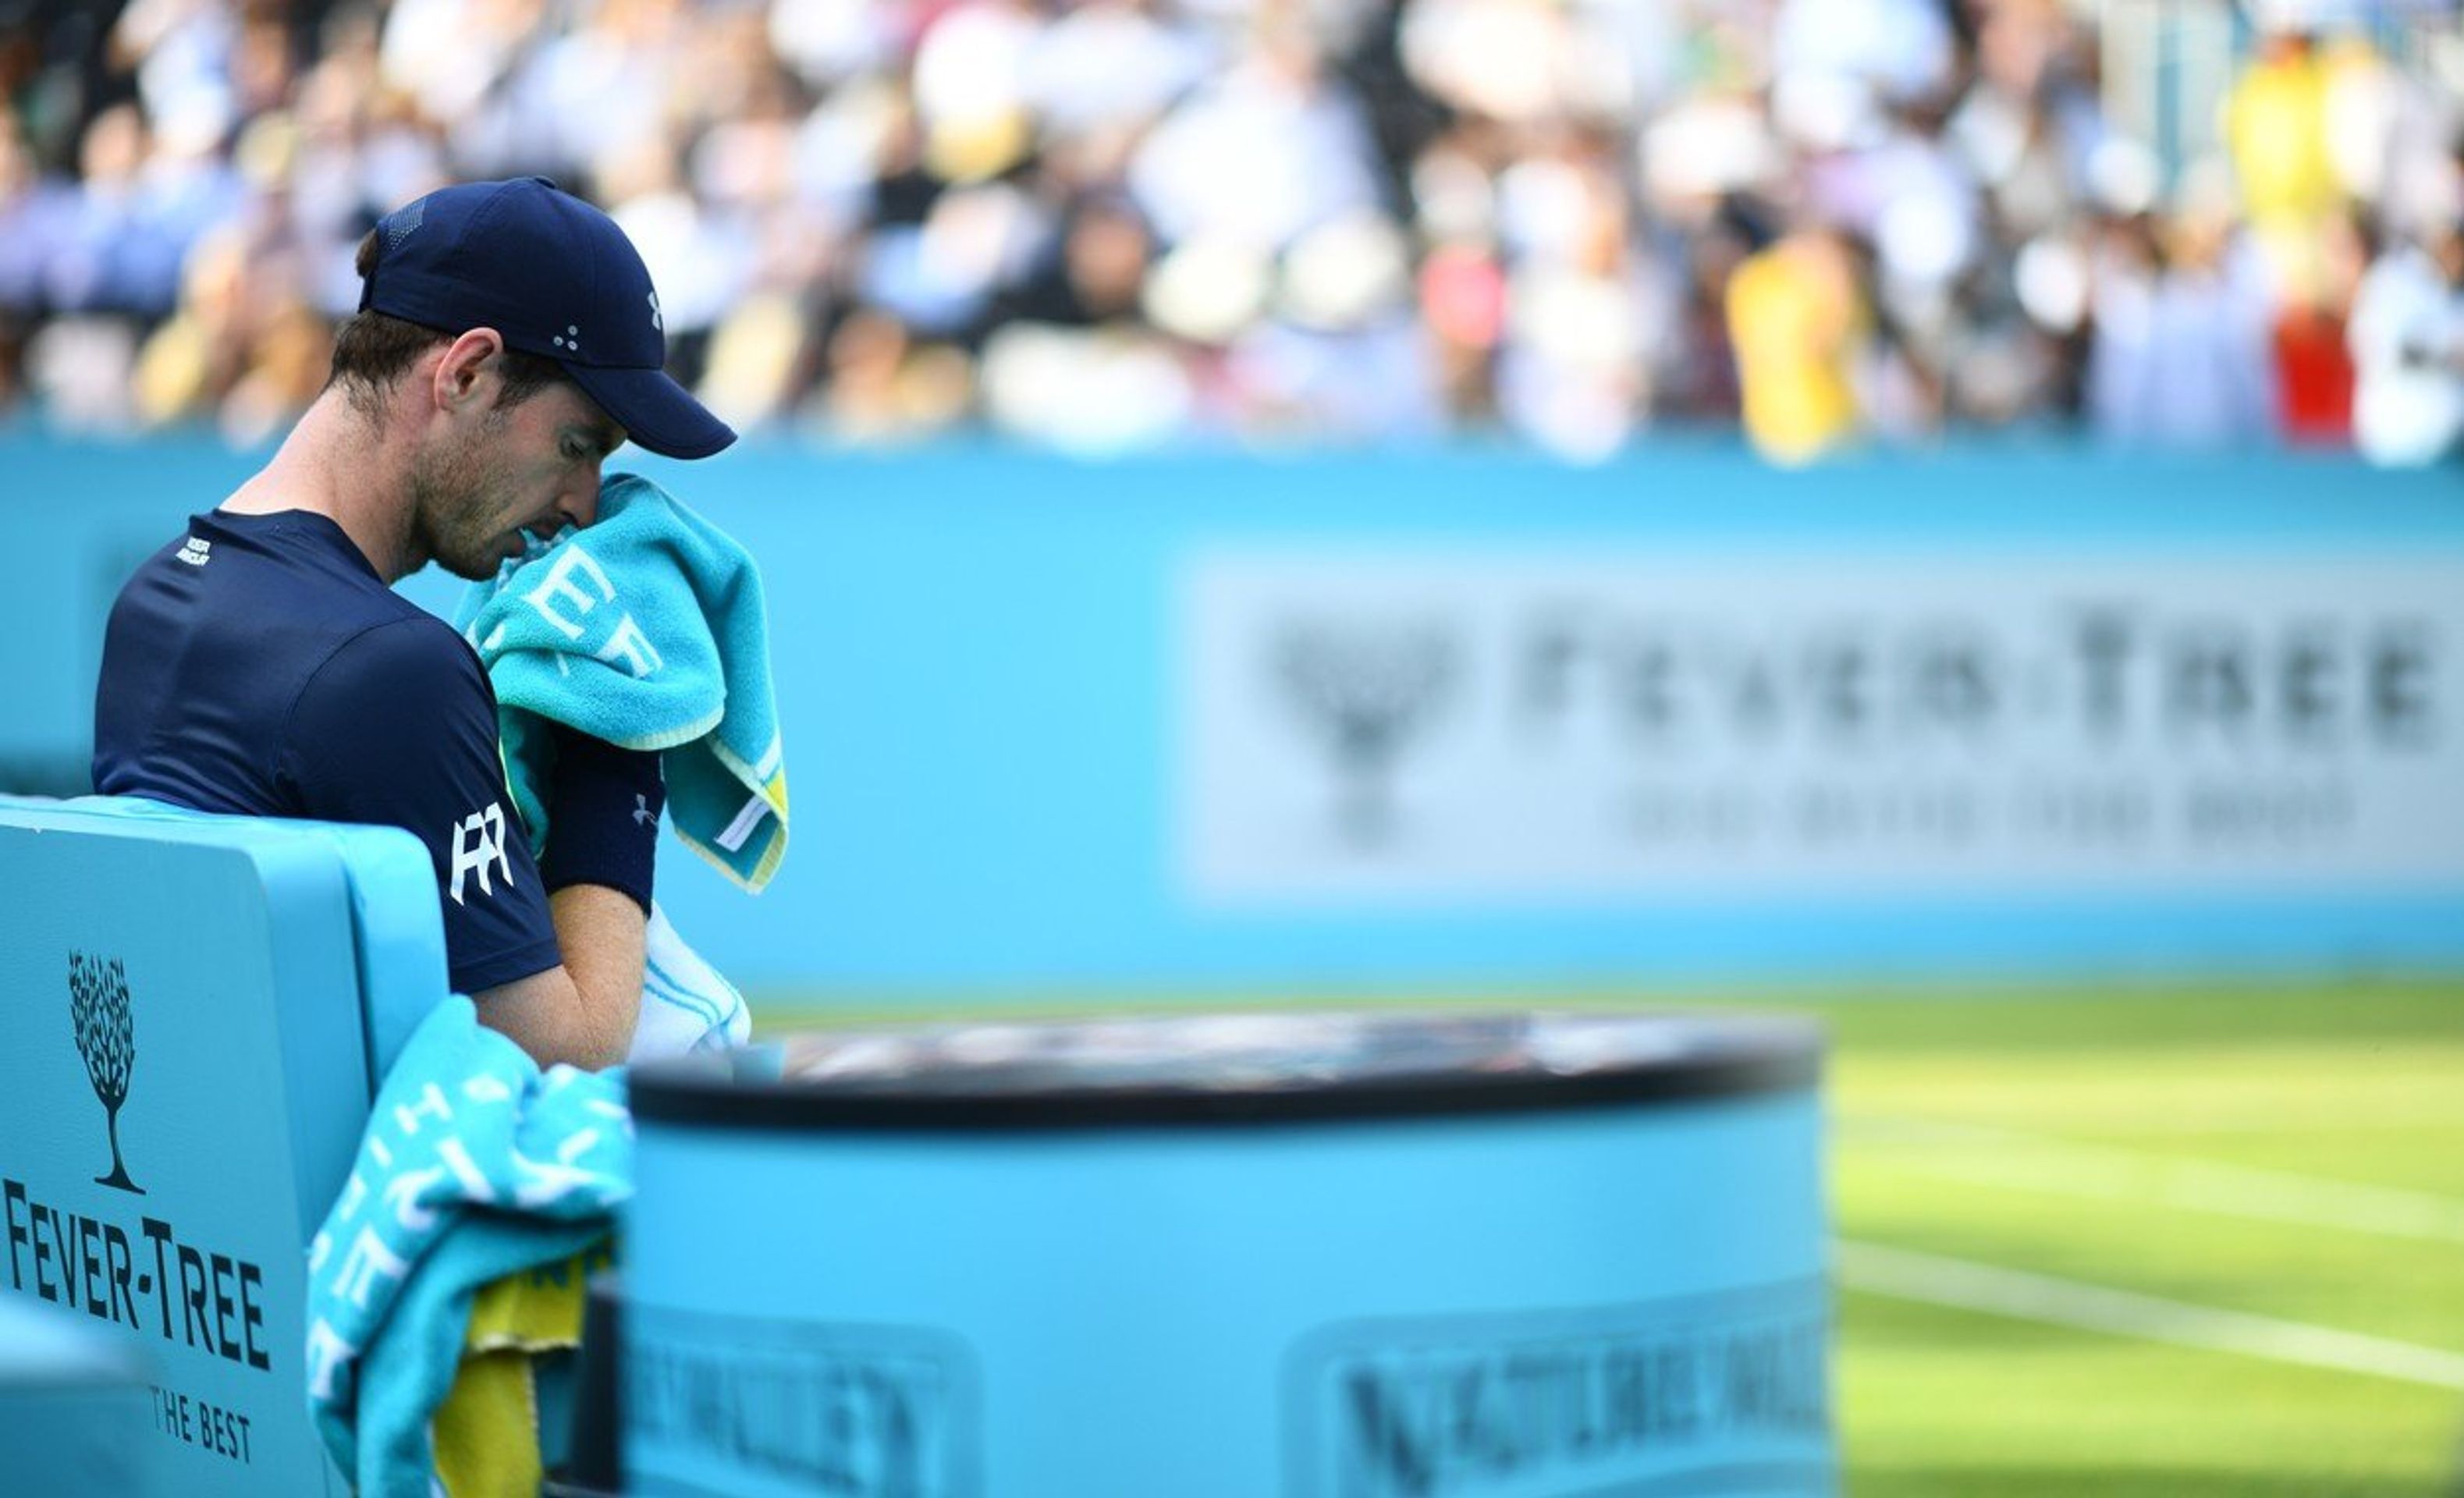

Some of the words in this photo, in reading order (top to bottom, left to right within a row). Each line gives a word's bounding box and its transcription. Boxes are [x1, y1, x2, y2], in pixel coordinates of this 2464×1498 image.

[3, 1178, 270, 1372] FEVER-TREE
[150, 1385, 192, 1443] THE
[198, 1400, 250, 1464] BEST
